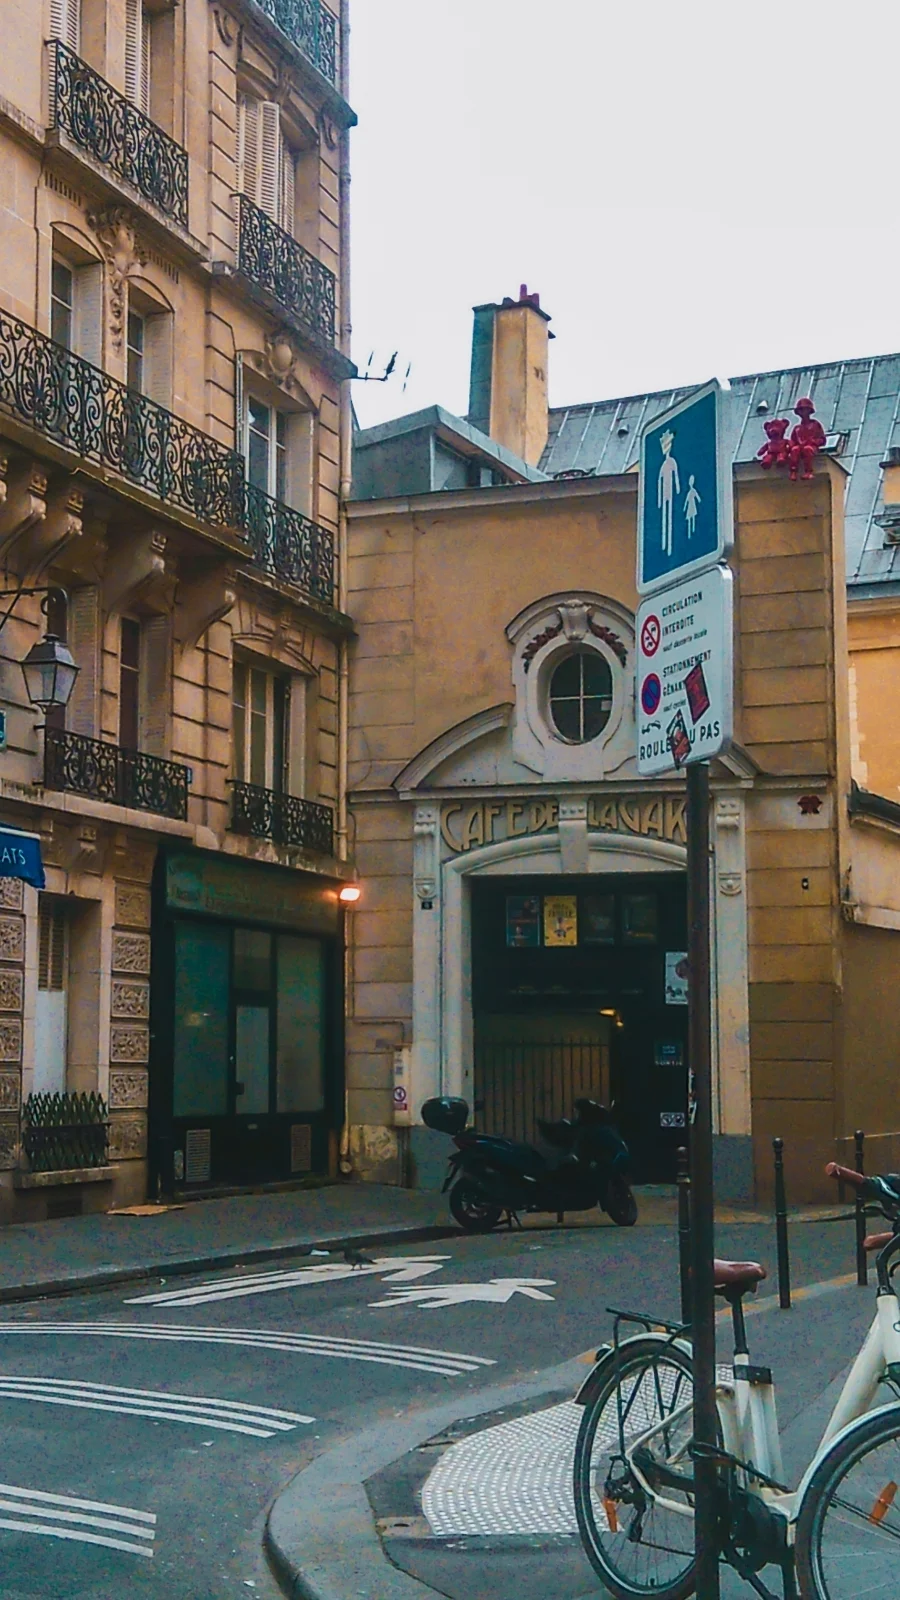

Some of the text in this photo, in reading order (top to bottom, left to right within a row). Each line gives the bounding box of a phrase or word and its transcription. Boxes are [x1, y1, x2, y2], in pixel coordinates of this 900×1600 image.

[662, 591, 703, 617] CIRCULATION
[662, 614, 694, 636] INTERDITE
[663, 649, 711, 677] STATIONNEMENT
[640, 740, 671, 760] ROULE
[700, 721, 720, 742] PAS
[529, 801, 559, 833] DE
[619, 796, 687, 843] GAR
[0, 846, 26, 865] ATS
